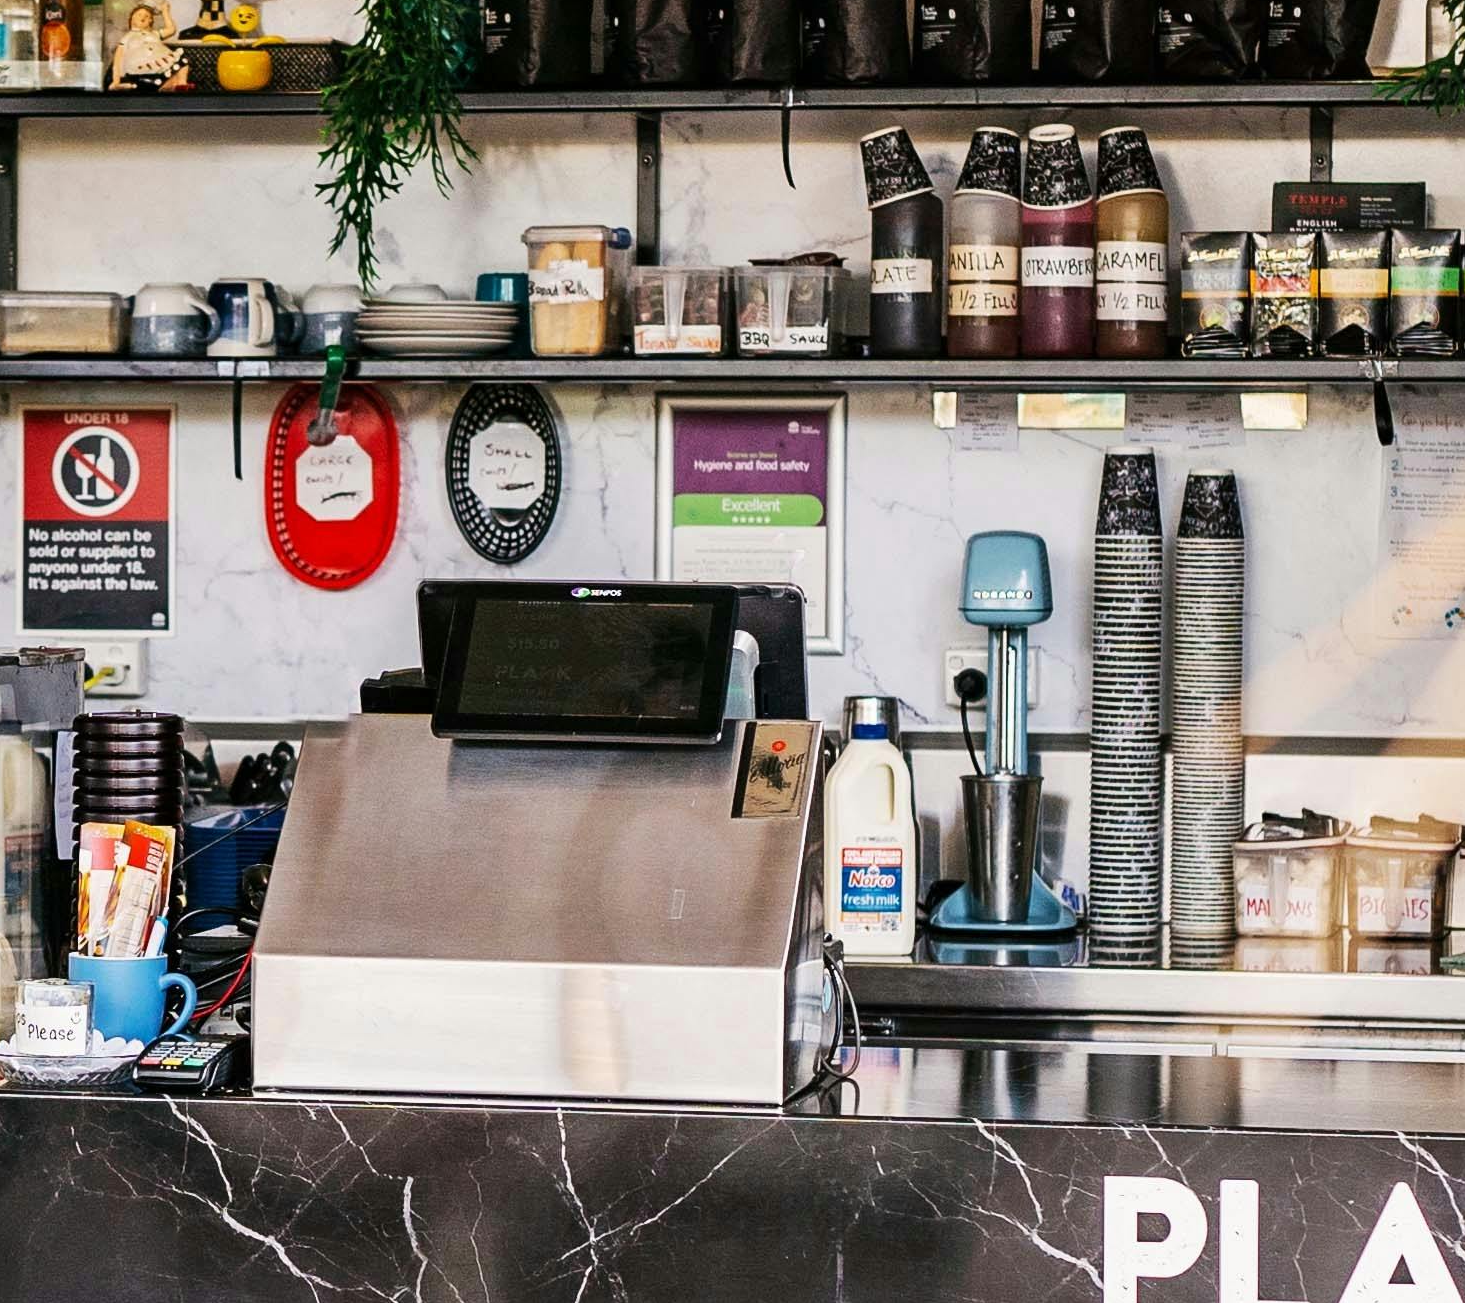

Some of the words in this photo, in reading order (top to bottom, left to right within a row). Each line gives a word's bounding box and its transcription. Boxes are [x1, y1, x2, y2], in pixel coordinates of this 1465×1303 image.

[1296, 219, 1337, 228] ENGLISH
[950, 251, 1004, 270] ANILLA
[1096, 252, 1164, 273] CARAMEL
[741, 331, 770, 347] BBQ
[64, 414, 111, 425] UNDER
[114, 414, 129, 425] 18
[694, 460, 733, 473] Hygiene
[735, 460, 754, 471] and
[756, 460, 778, 471] food
[780, 460, 810, 473] safety
[721, 497, 781, 513] Excellent
[28, 529, 48, 542] No
[52, 528, 102, 542] alcohol
[104, 530, 131, 542] can
[133, 529, 152, 542] be
[28, 545, 58, 558] sold
[61, 547, 76, 558] or
[79, 545, 138, 561] supplied
[141, 546, 156, 558] to
[28, 562, 79, 577] anyone
[81, 561, 122, 574] under
[125, 561, 146, 574] 18.
[28, 577, 49, 590] It's
[51, 578, 102, 593] against
[105, 577, 128, 590] the
[130, 578, 158, 591] law.
[848, 869, 896, 889] Norco
[844, 892, 874, 906] fresh
[876, 892, 899, 906] milk
[28, 1023, 76, 1041] Please
